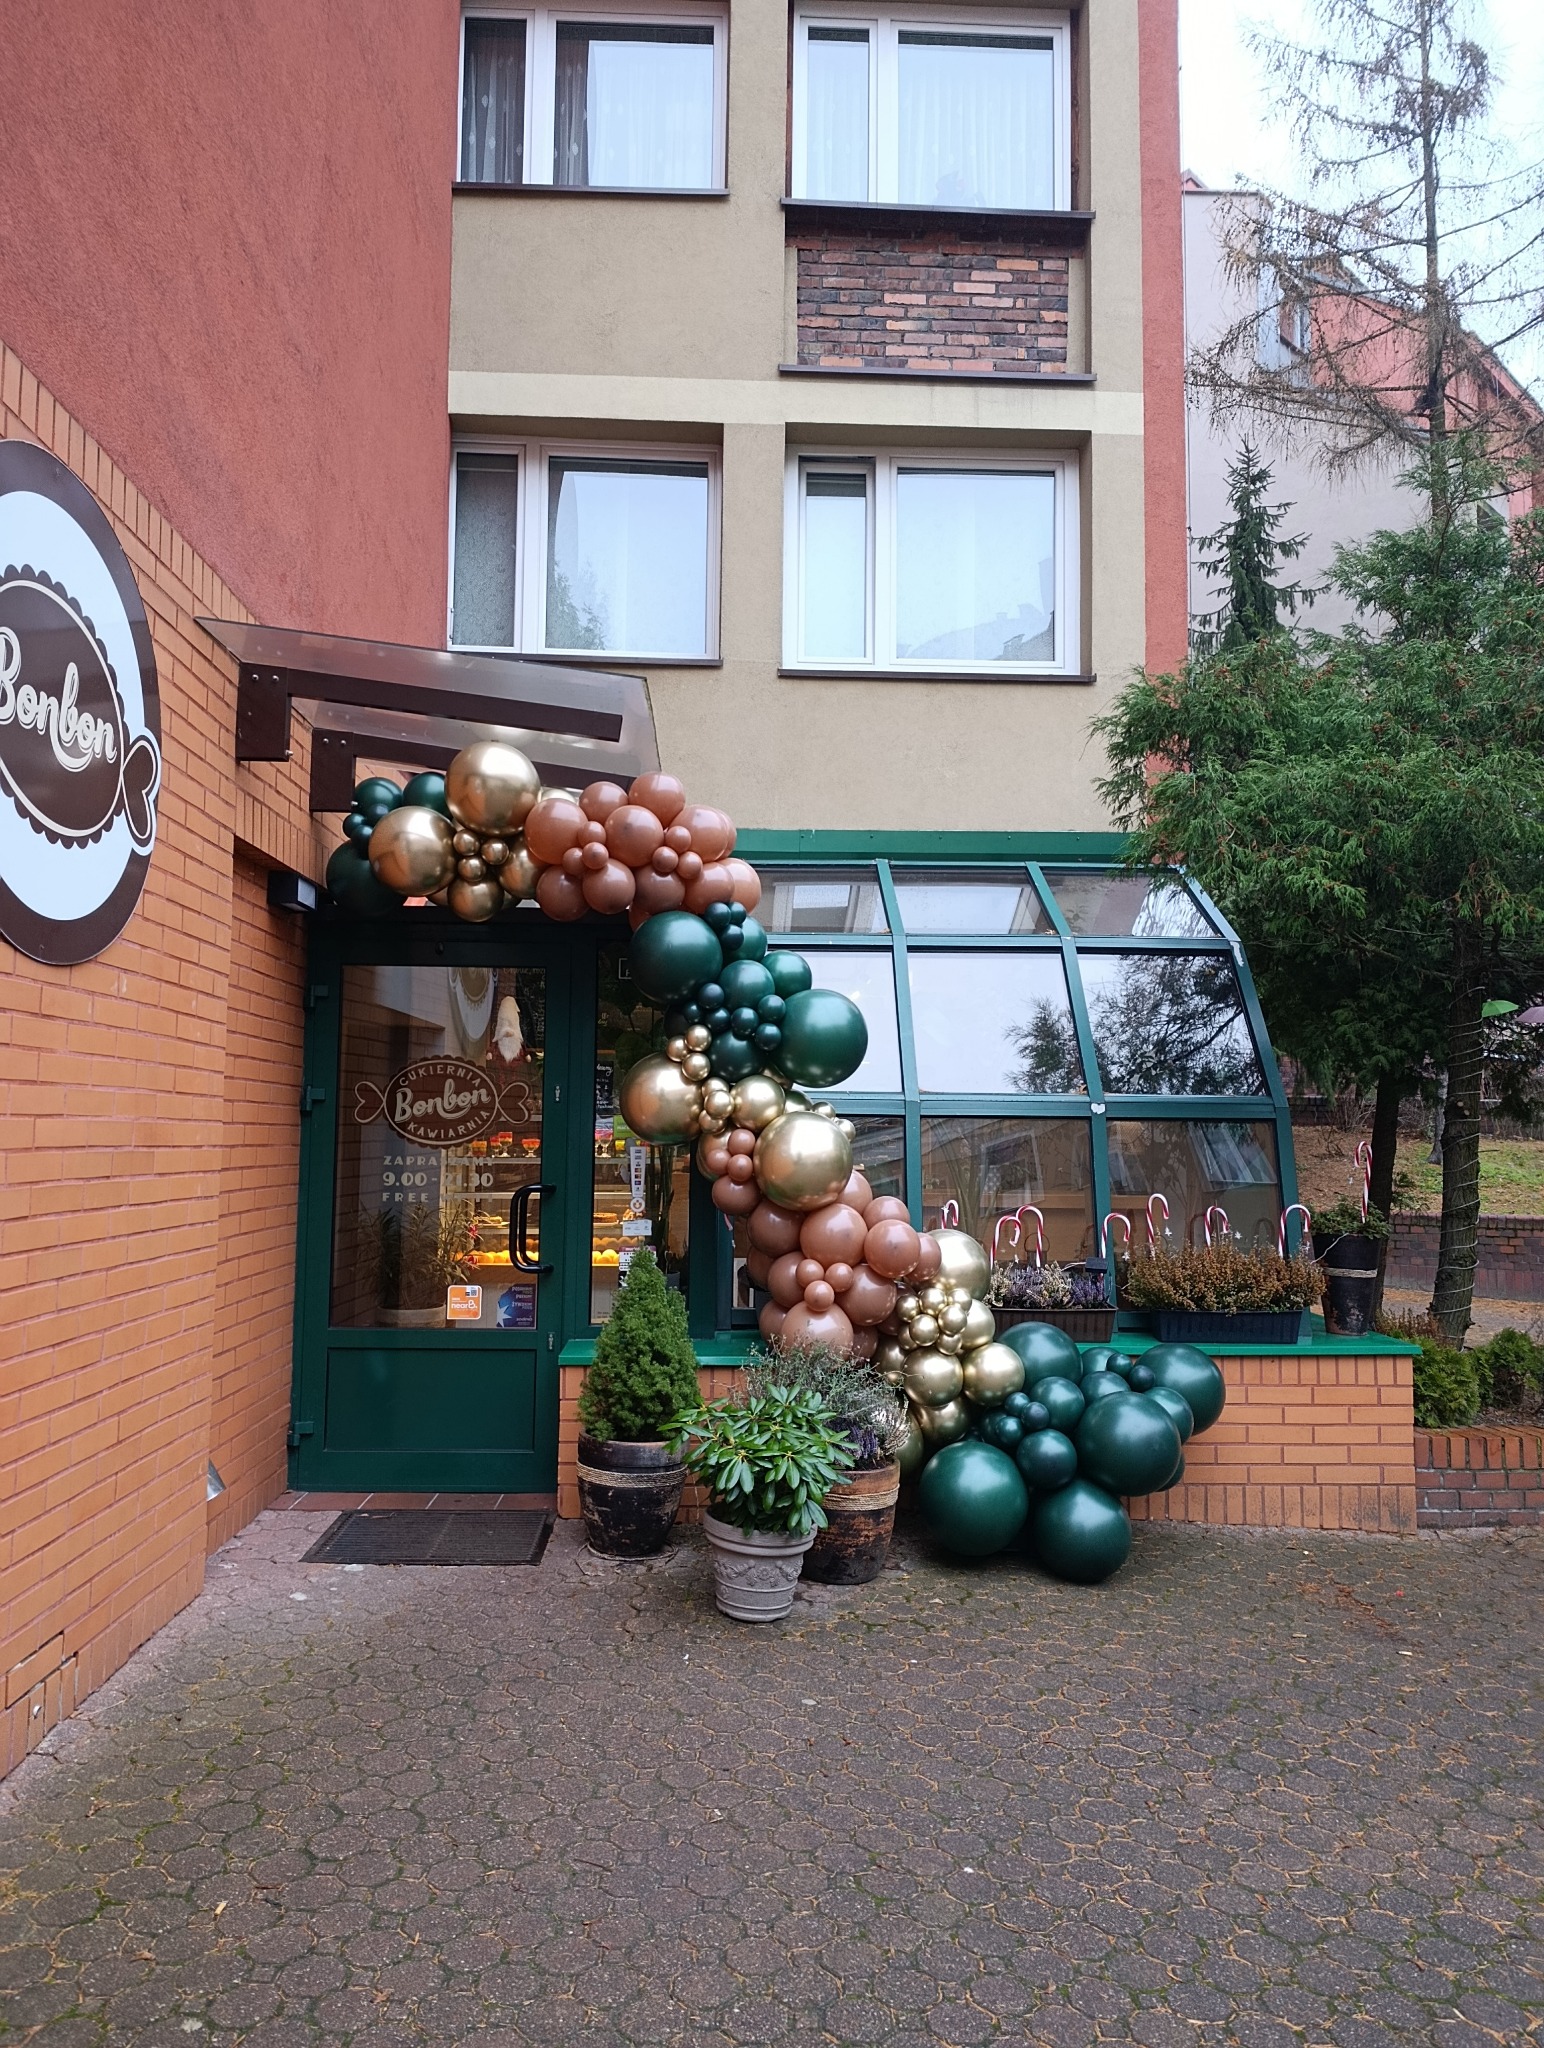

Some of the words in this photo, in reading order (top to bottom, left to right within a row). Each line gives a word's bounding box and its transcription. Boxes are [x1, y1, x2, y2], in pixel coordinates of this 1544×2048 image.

[0, 626, 118, 773] Bonbon
[399, 1064, 482, 1088] CUKIERNIA
[394, 1078, 492, 1124] Bonbon
[407, 1110, 491, 1139] KAWIARNIA
[383, 1155, 494, 1166] ZAPRASZAMY
[382, 1172, 428, 1187] 9.00
[382, 1193, 429, 1202] FREE
